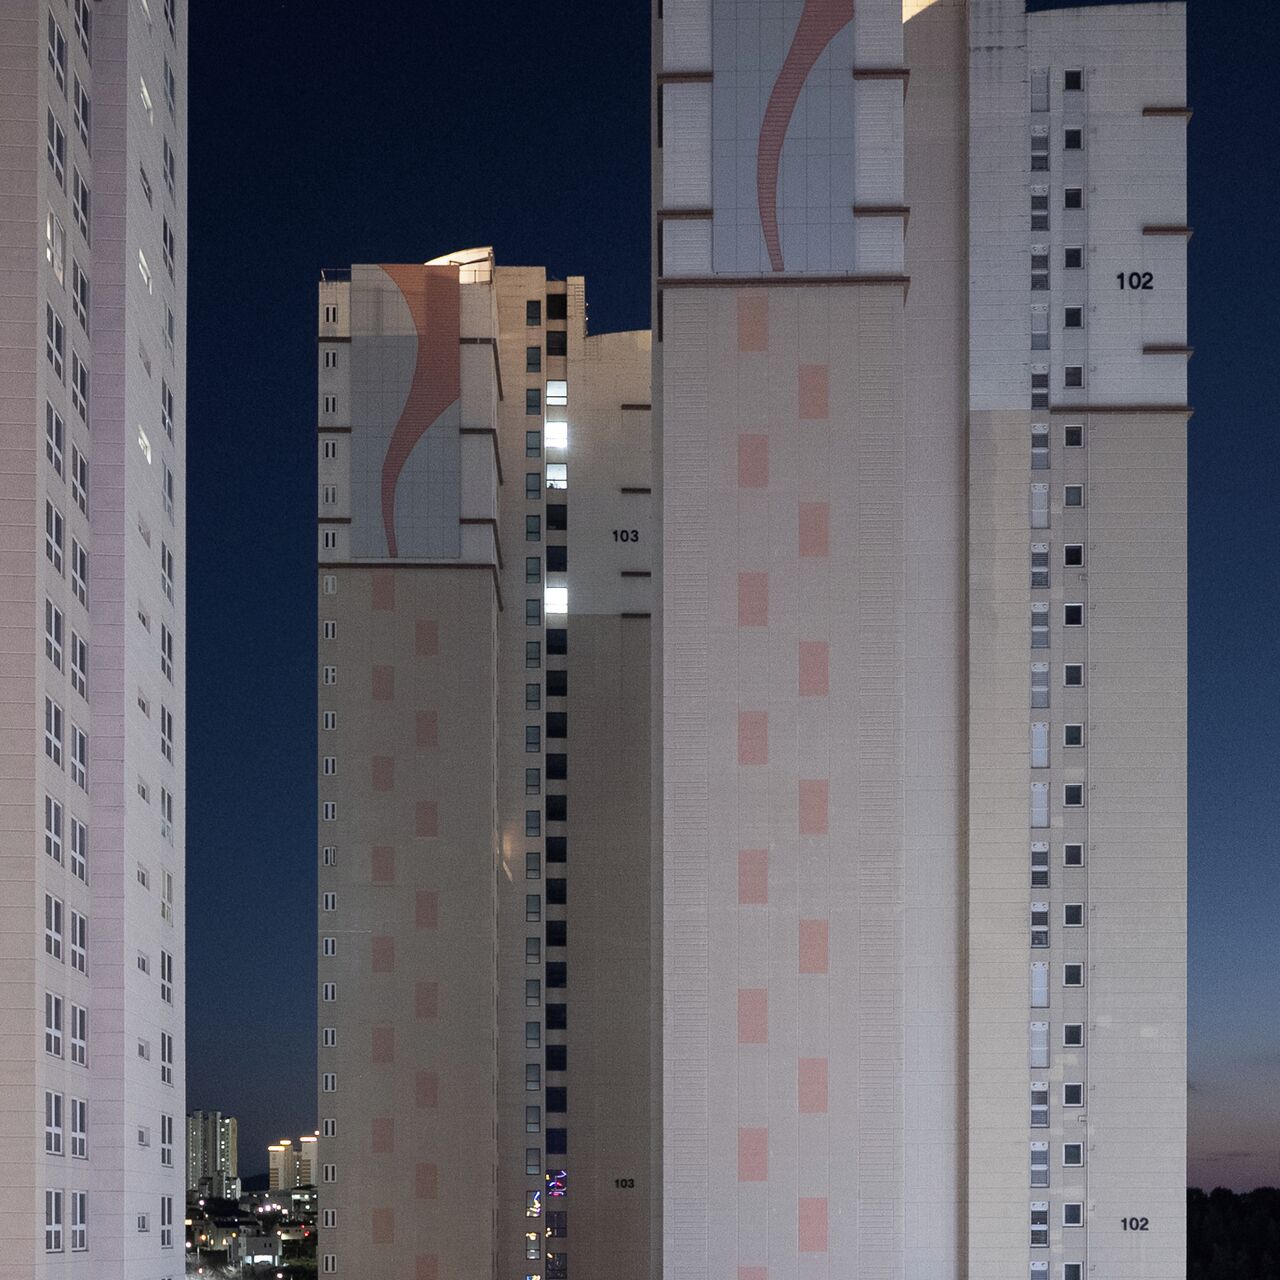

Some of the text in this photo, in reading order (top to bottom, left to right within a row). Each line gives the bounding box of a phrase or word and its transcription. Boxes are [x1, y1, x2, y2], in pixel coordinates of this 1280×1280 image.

[1116, 272, 1153, 290] 102
[612, 529, 639, 542] 103
[615, 1178, 635, 1189] 103
[1121, 1217, 1149, 1231] 102
